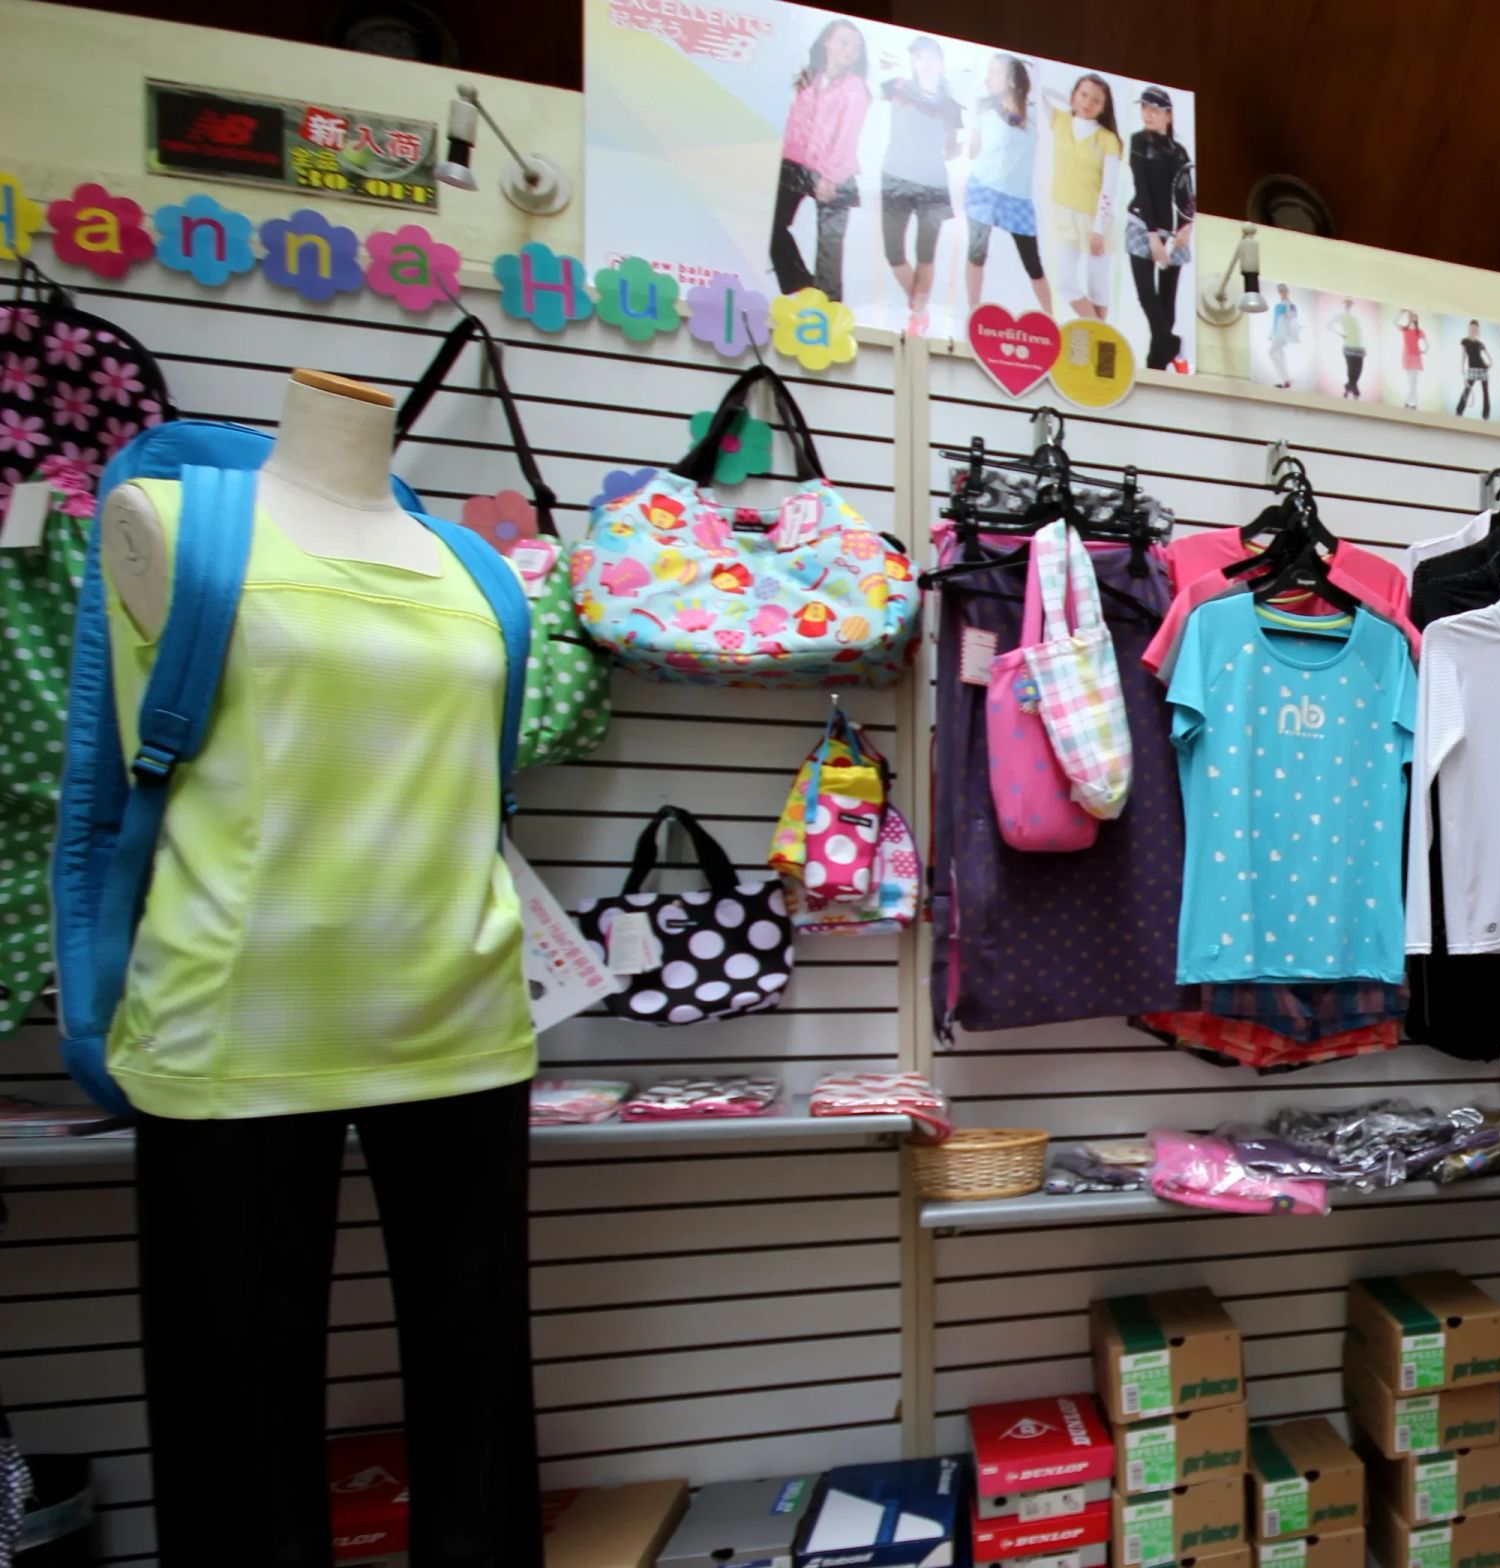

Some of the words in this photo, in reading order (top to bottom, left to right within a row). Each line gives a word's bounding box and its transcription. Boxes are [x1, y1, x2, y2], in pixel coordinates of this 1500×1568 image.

[307, 113, 421, 162] 新入荷
[520, 252, 830, 348] Hula
[1278, 695, 1326, 732] nb
[1019, 1461, 1090, 1481] DUNLOP
[1015, 1528, 1085, 1548] DUNLOP
